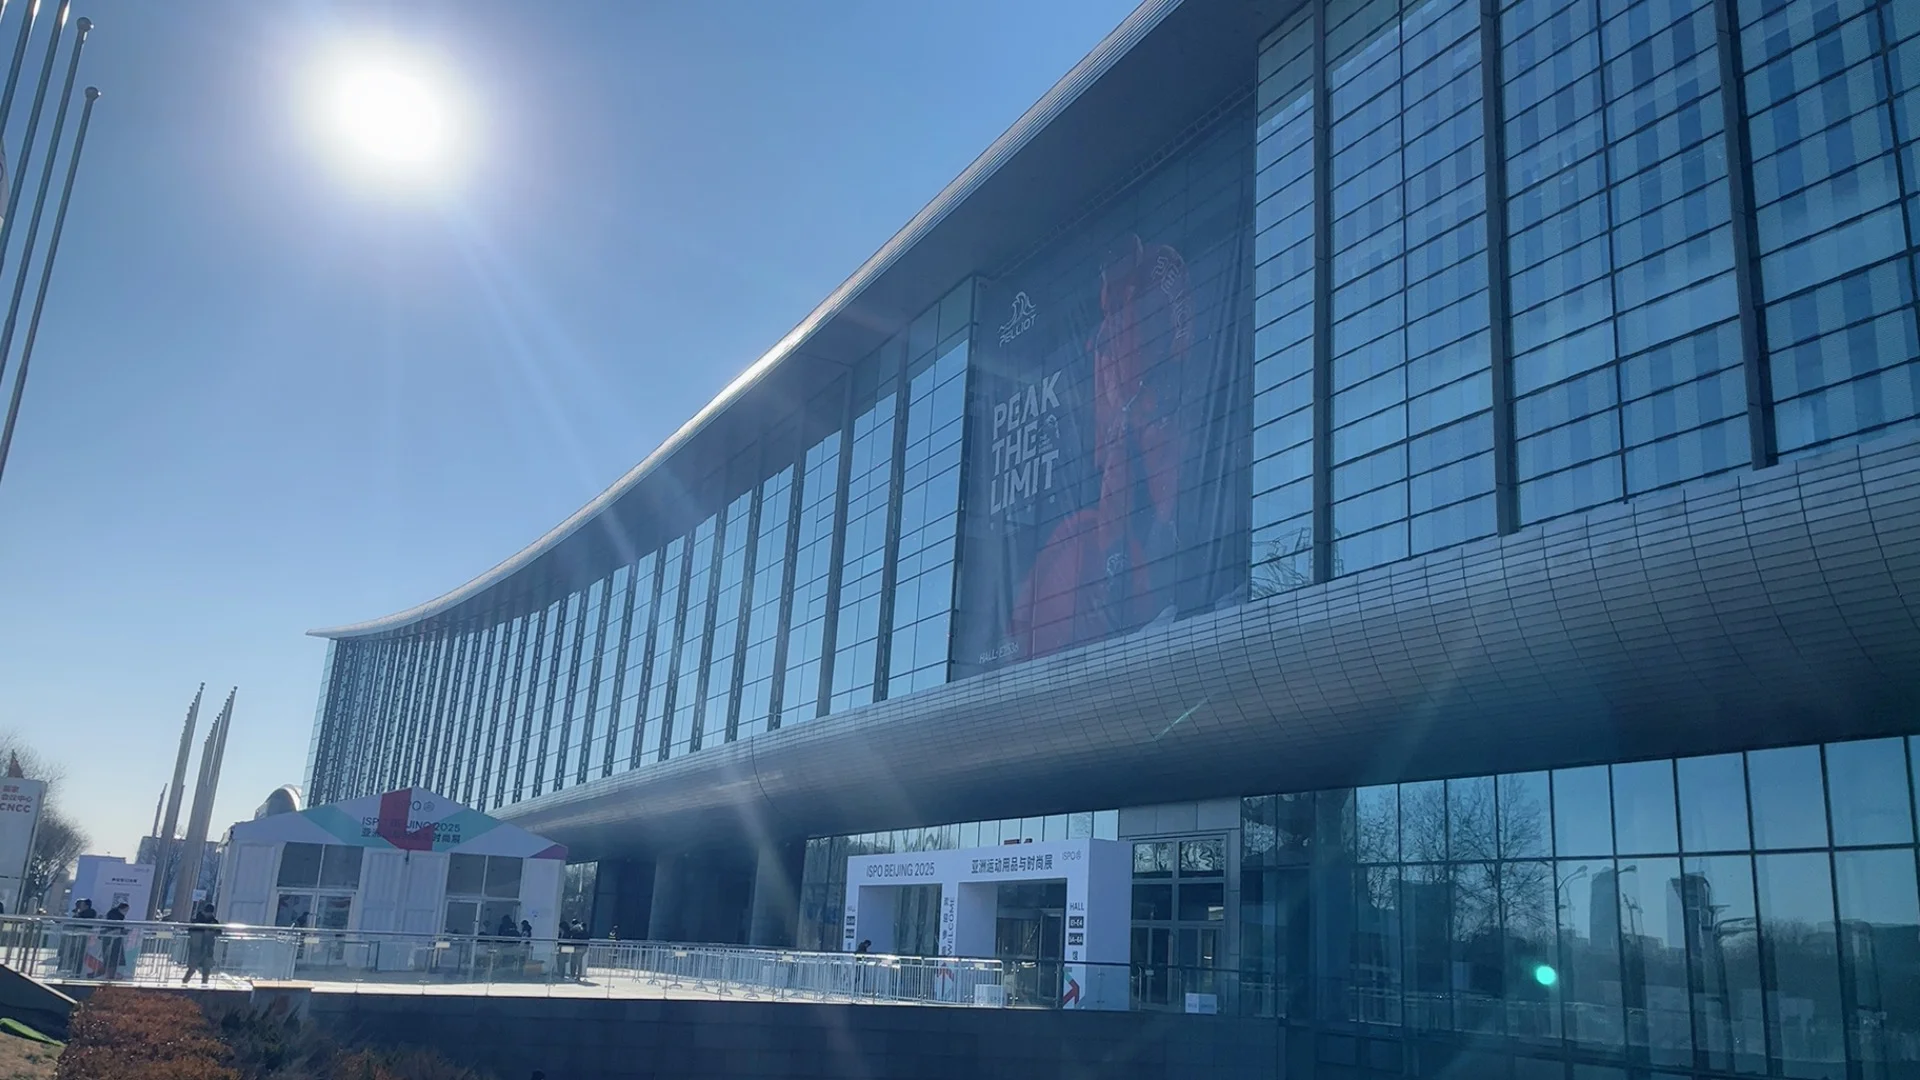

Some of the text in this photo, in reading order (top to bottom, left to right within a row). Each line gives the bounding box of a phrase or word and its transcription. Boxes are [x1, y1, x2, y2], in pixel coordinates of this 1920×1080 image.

[1000, 314, 1036, 347] PELLIOT
[993, 369, 1061, 440] PEAK
[992, 419, 1038, 476] THE
[990, 450, 1059, 516] LIMIT
[0, 802, 31, 813] CNCC
[433, 821, 461, 832] 2025
[866, 862, 935, 878] ISPO BEIJING 2025
[971, 854, 1053, 874] 亚洲运动用品与时尚展
[1069, 902, 1084, 911] HALL
[947, 896, 955, 955] WELCOME
